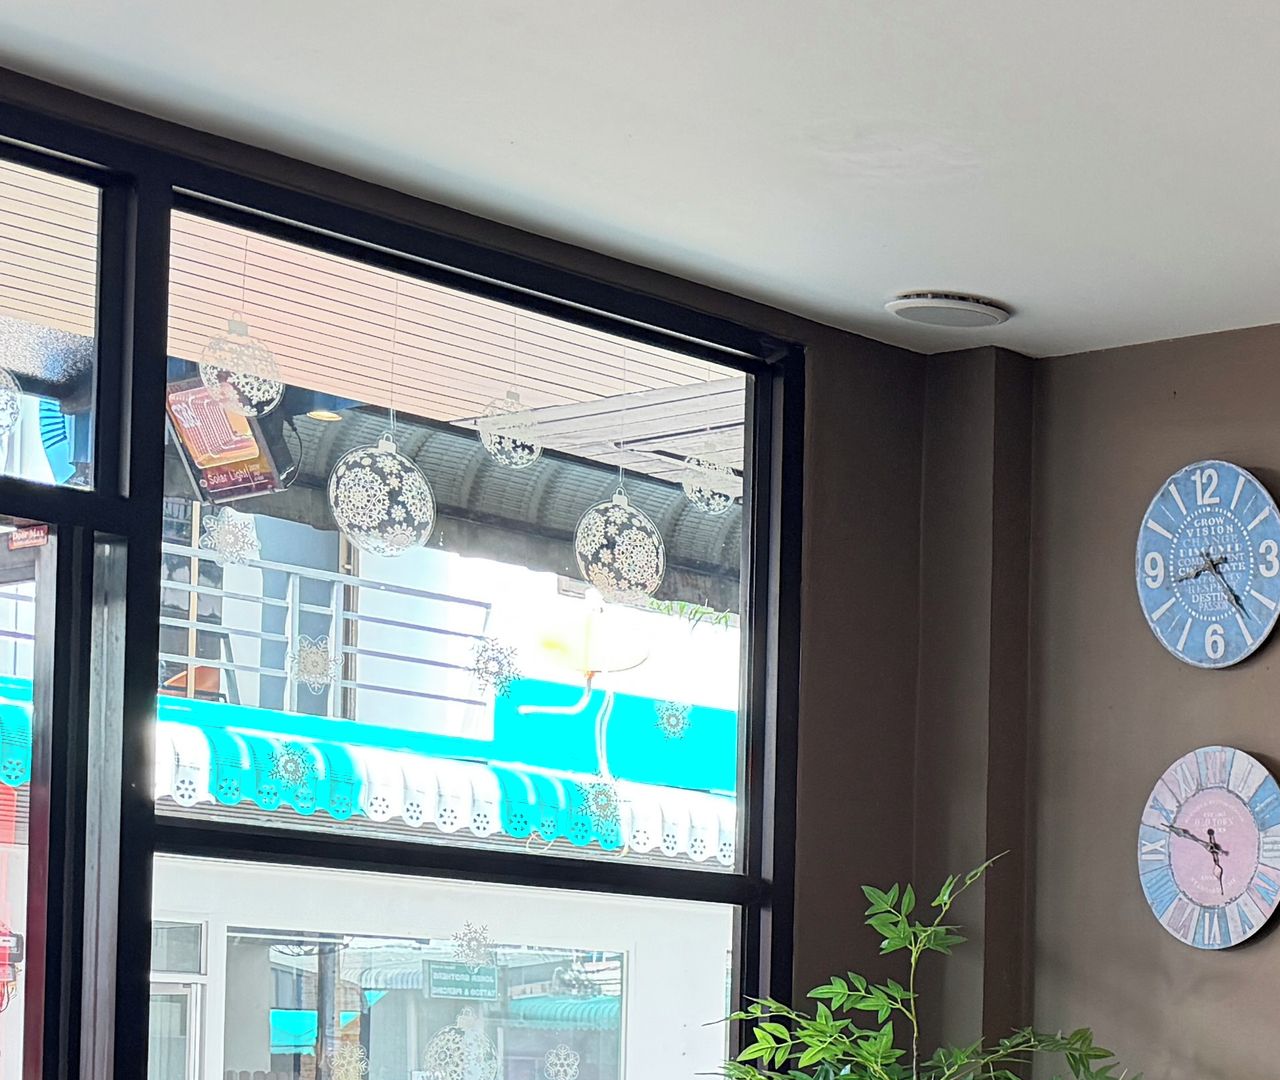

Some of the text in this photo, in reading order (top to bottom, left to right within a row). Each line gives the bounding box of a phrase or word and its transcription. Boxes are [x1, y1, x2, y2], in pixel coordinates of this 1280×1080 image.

[208, 471, 228, 484] Solar
[1191, 468, 1220, 505] 12
[1187, 525, 1234, 537] VISION
[1194, 516, 1224, 527] GROW
[1144, 552, 1164, 589] 9
[1259, 540, 1279, 577] 3
[1204, 624, 1224, 660] 6
